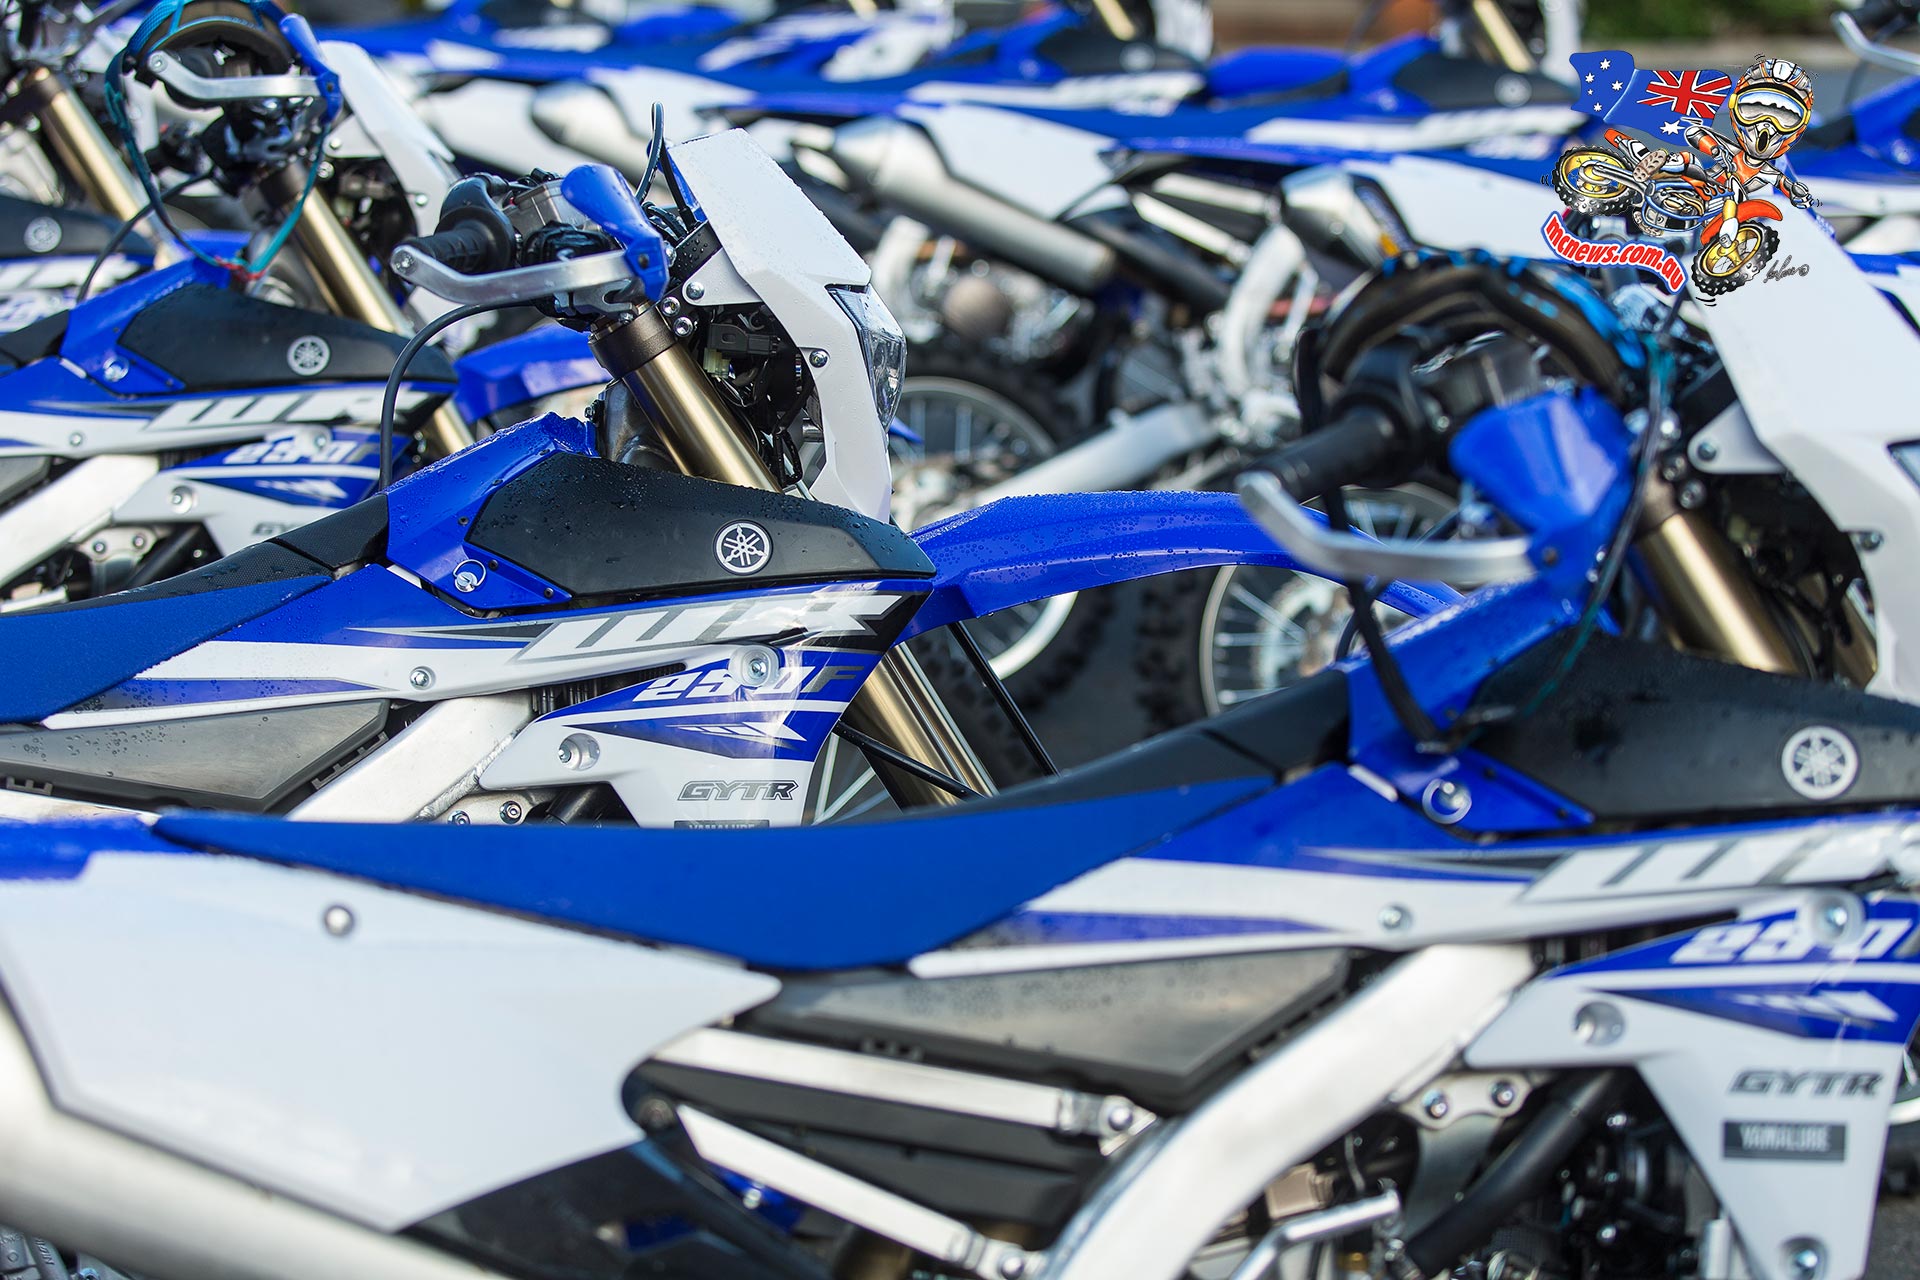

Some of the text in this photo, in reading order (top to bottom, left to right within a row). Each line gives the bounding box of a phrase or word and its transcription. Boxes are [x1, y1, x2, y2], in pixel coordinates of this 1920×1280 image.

[514, 594, 906, 661] WR
[633, 665, 864, 701] 250F
[677, 780, 799, 801] GYTR
[1669, 918, 1920, 964] 250
[1729, 1069, 1884, 1096] GYTR
